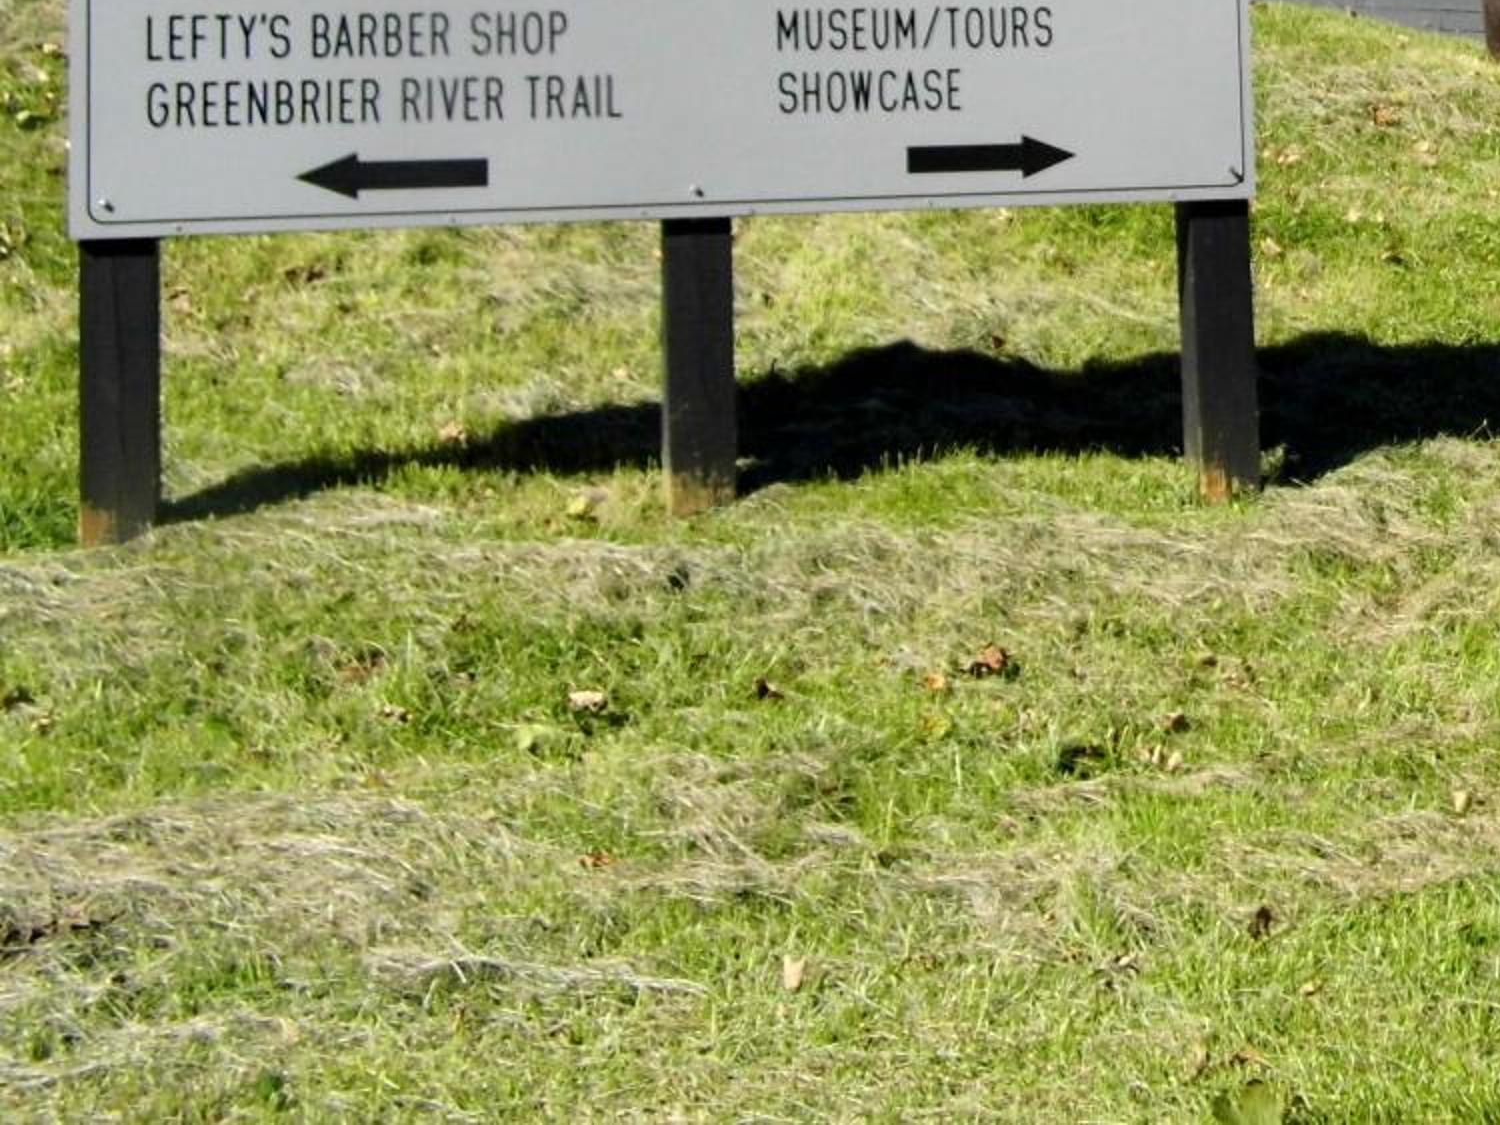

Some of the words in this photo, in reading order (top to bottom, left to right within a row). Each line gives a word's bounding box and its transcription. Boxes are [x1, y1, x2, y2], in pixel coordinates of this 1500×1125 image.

[146, 12, 292, 62] LEFTY'S
[311, 11, 450, 59] BARBER
[470, 10, 568, 57] SHOP
[146, 76, 381, 129] GREENBRIER
[401, 75, 504, 122] RIVER
[525, 74, 623, 119] TRAIL
[777, 68, 962, 115] SHOWCASE
